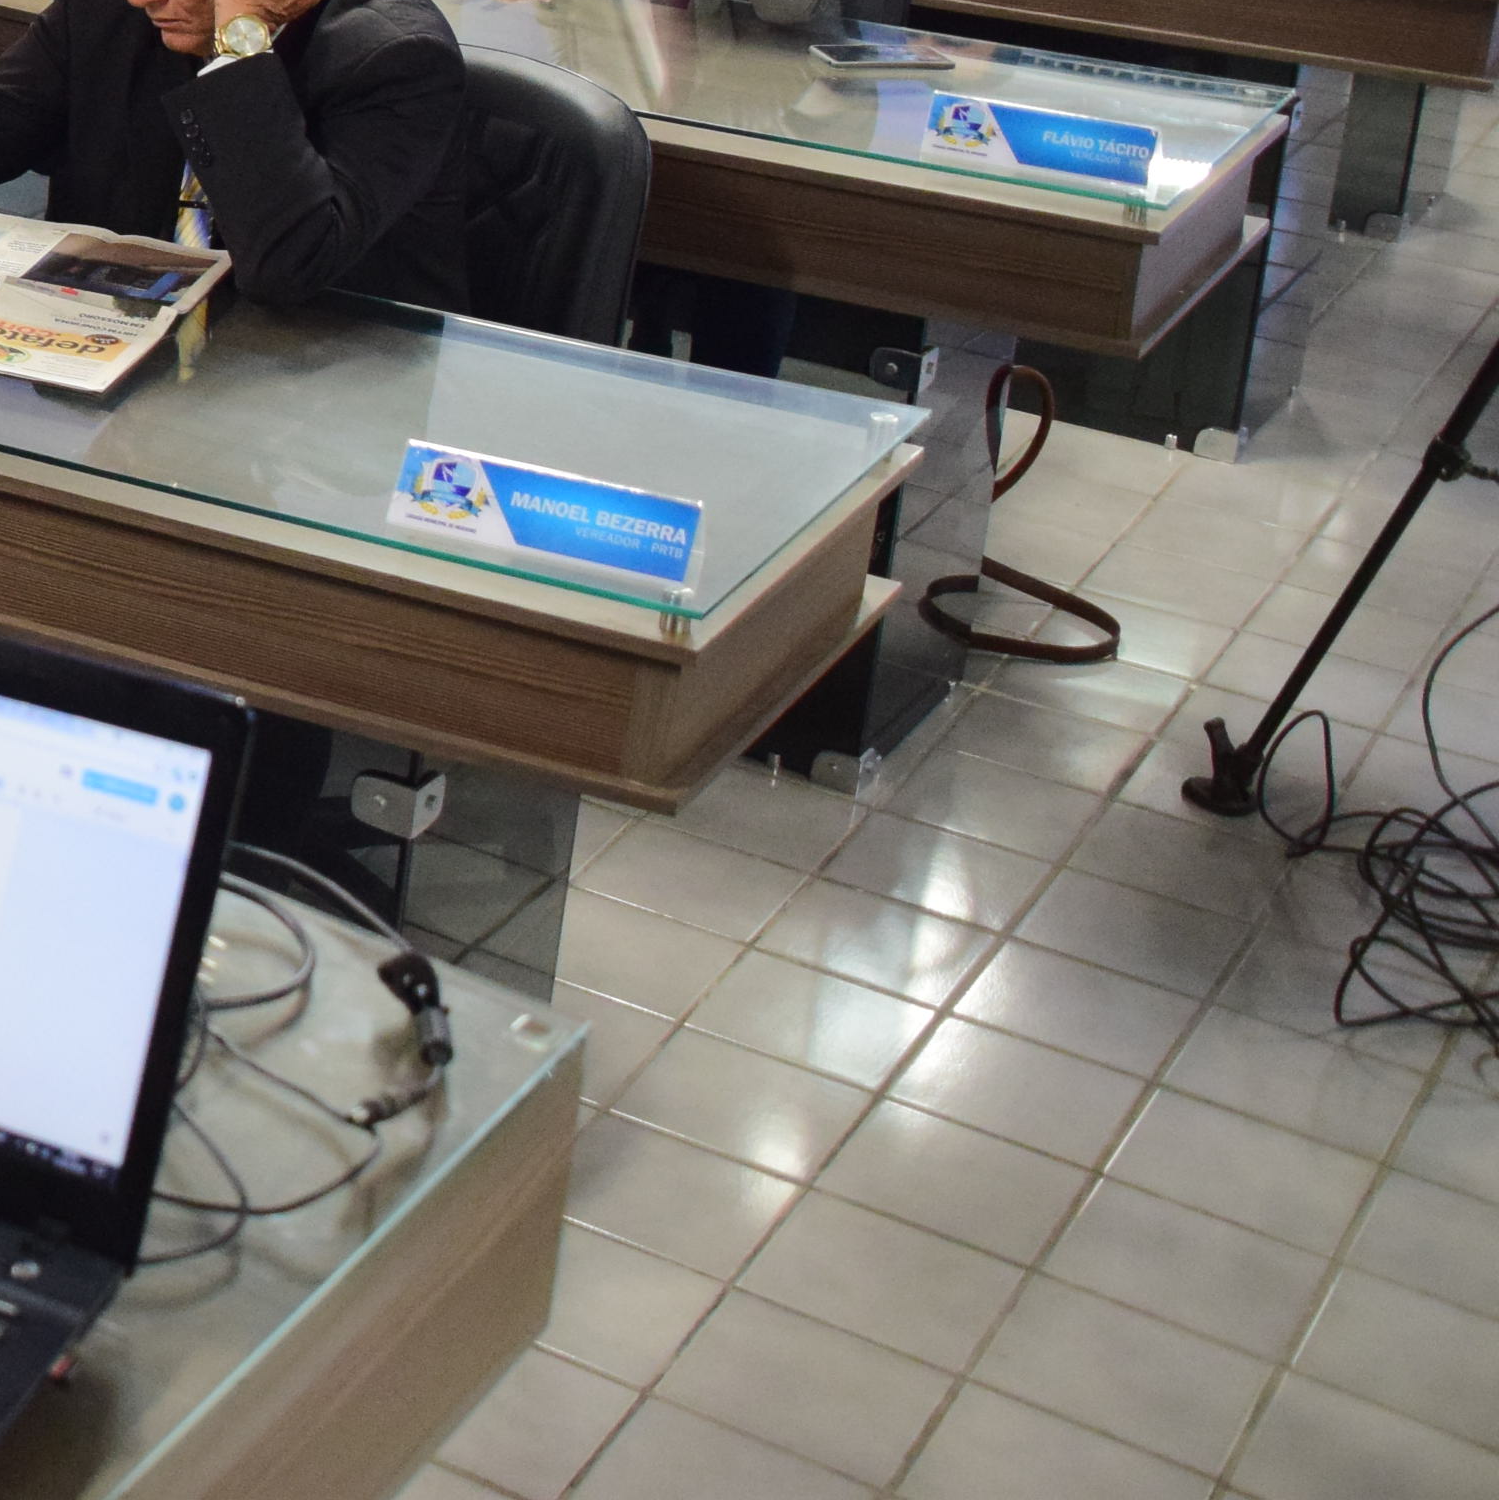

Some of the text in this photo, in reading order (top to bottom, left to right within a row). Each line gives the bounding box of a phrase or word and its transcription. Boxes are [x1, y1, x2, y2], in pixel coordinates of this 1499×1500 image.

[1042, 130, 1150, 158] FLÁVIO TÁCITO
[510, 491, 687, 546] MANOEL BEZERRA
[575, 526, 684, 560] VEREADOR PRTB
